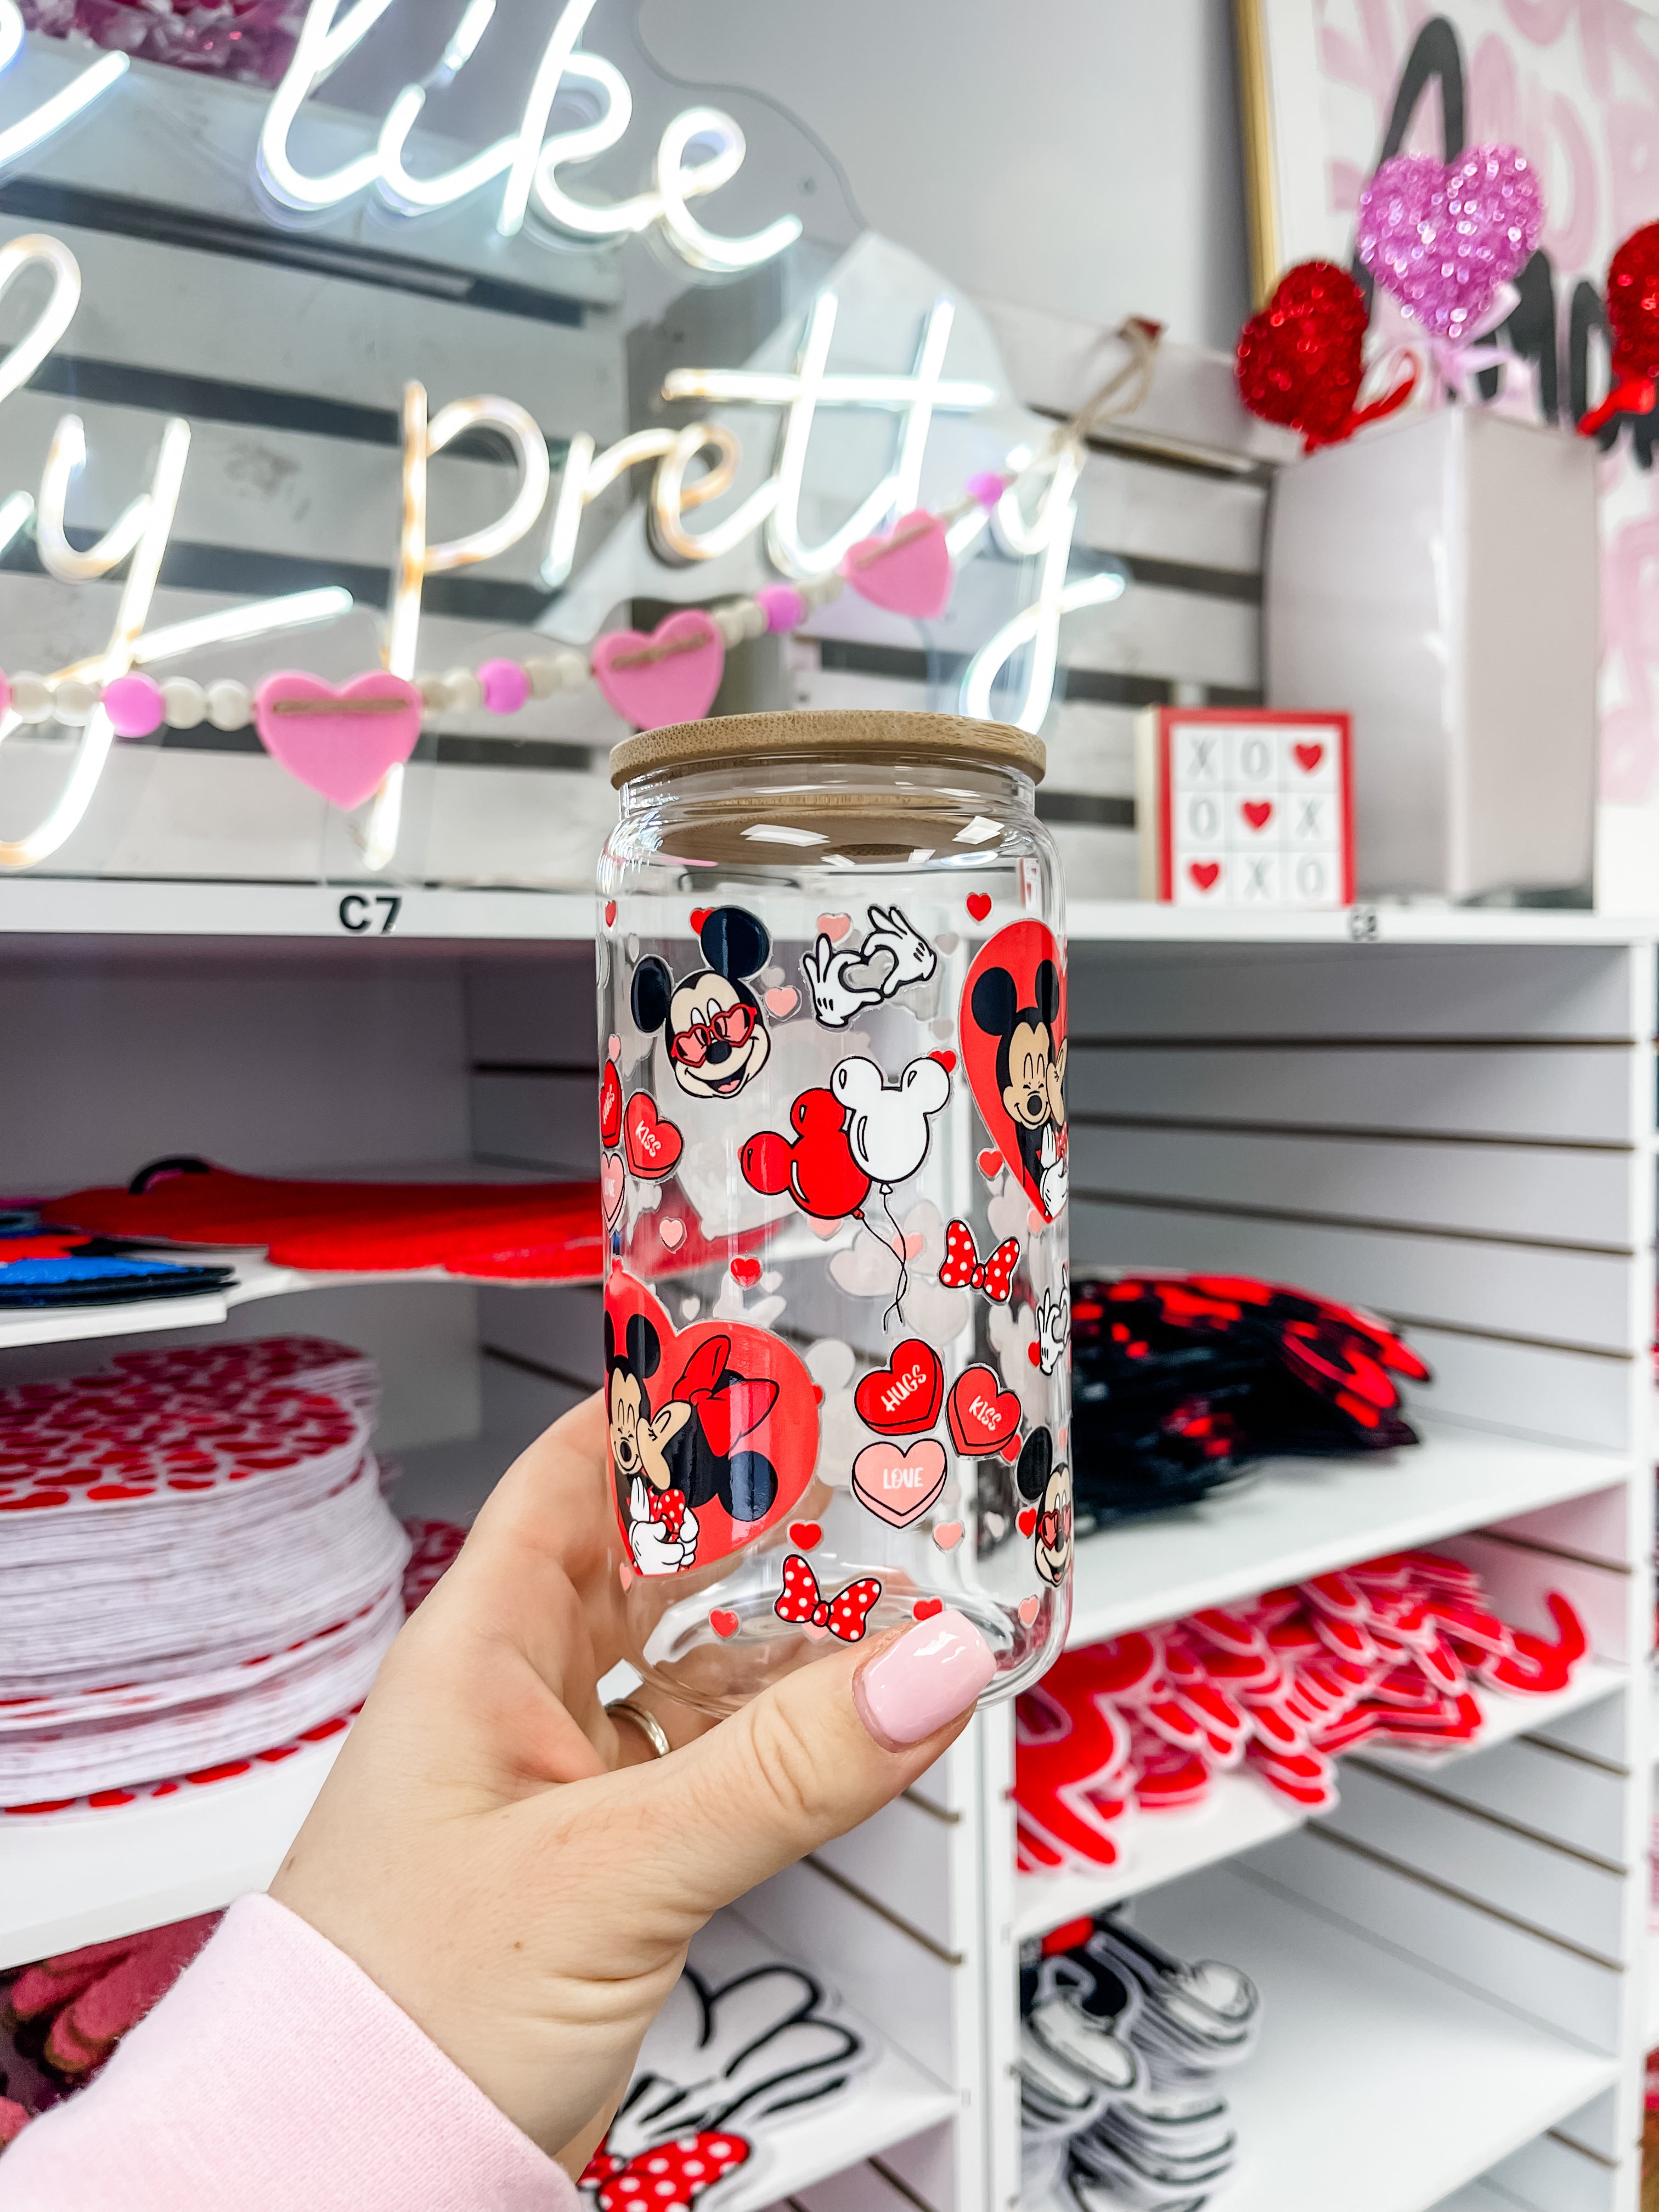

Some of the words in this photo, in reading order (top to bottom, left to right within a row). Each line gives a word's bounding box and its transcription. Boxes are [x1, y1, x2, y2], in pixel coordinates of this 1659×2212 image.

[257, 0, 804, 273] like
[363, 290, 1126, 871] pretty
[338, 895, 403, 934] C7
[635, 1120, 662, 1157] KISS
[881, 1364, 927, 1413] HUGS
[968, 1395, 1002, 1431] KISS
[883, 1467, 924, 1489] LOVE
